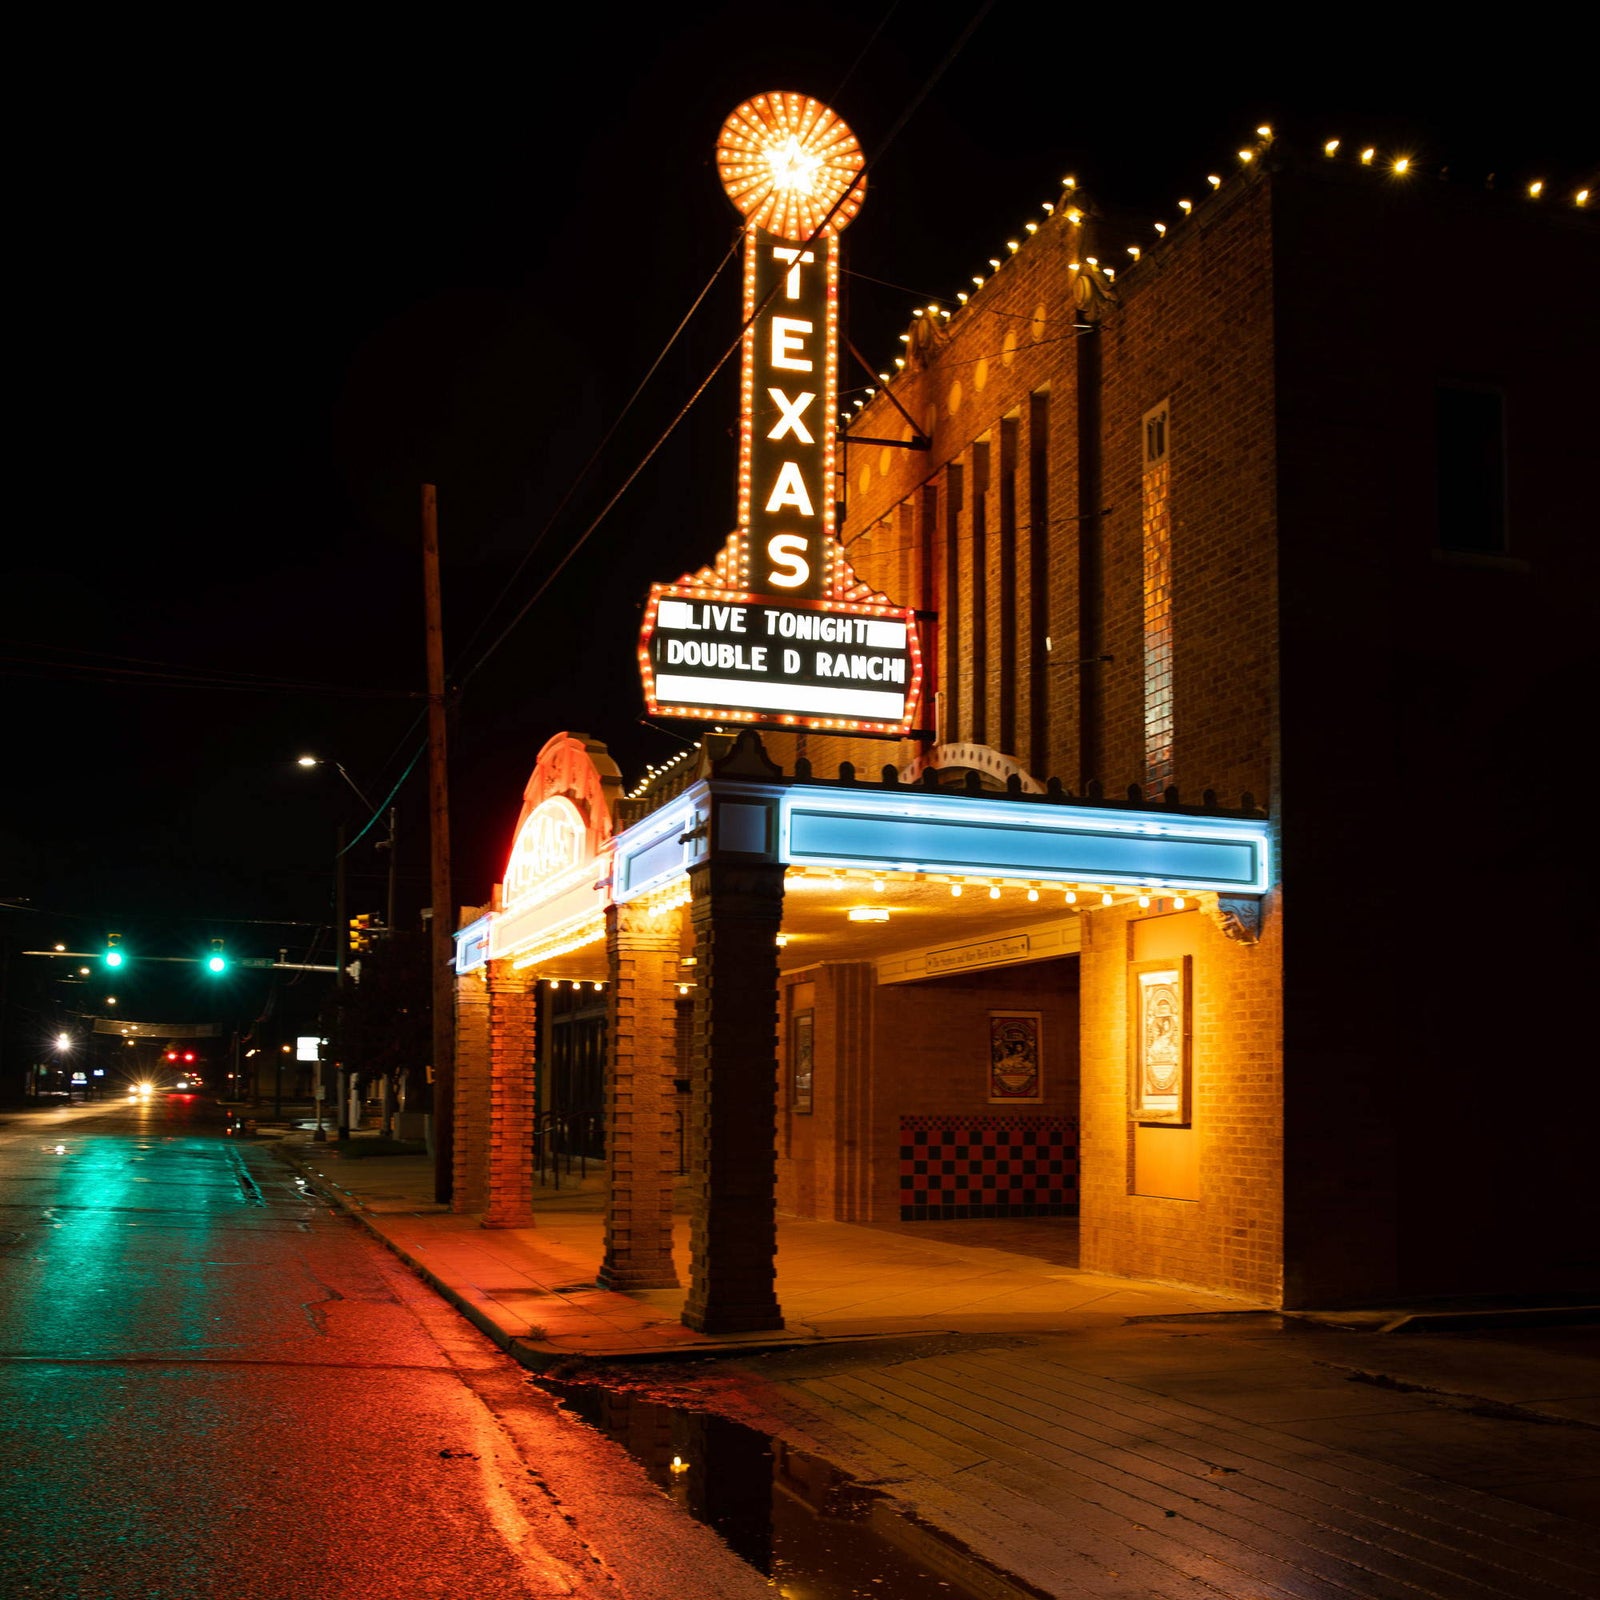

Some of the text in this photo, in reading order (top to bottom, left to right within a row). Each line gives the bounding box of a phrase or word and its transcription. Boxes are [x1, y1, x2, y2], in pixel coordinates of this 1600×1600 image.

[765, 247, 816, 588] TEXAS
[687, 605, 868, 644] LIVE TONIGHT
[668, 639, 901, 682] DOUBLE D RANCH
